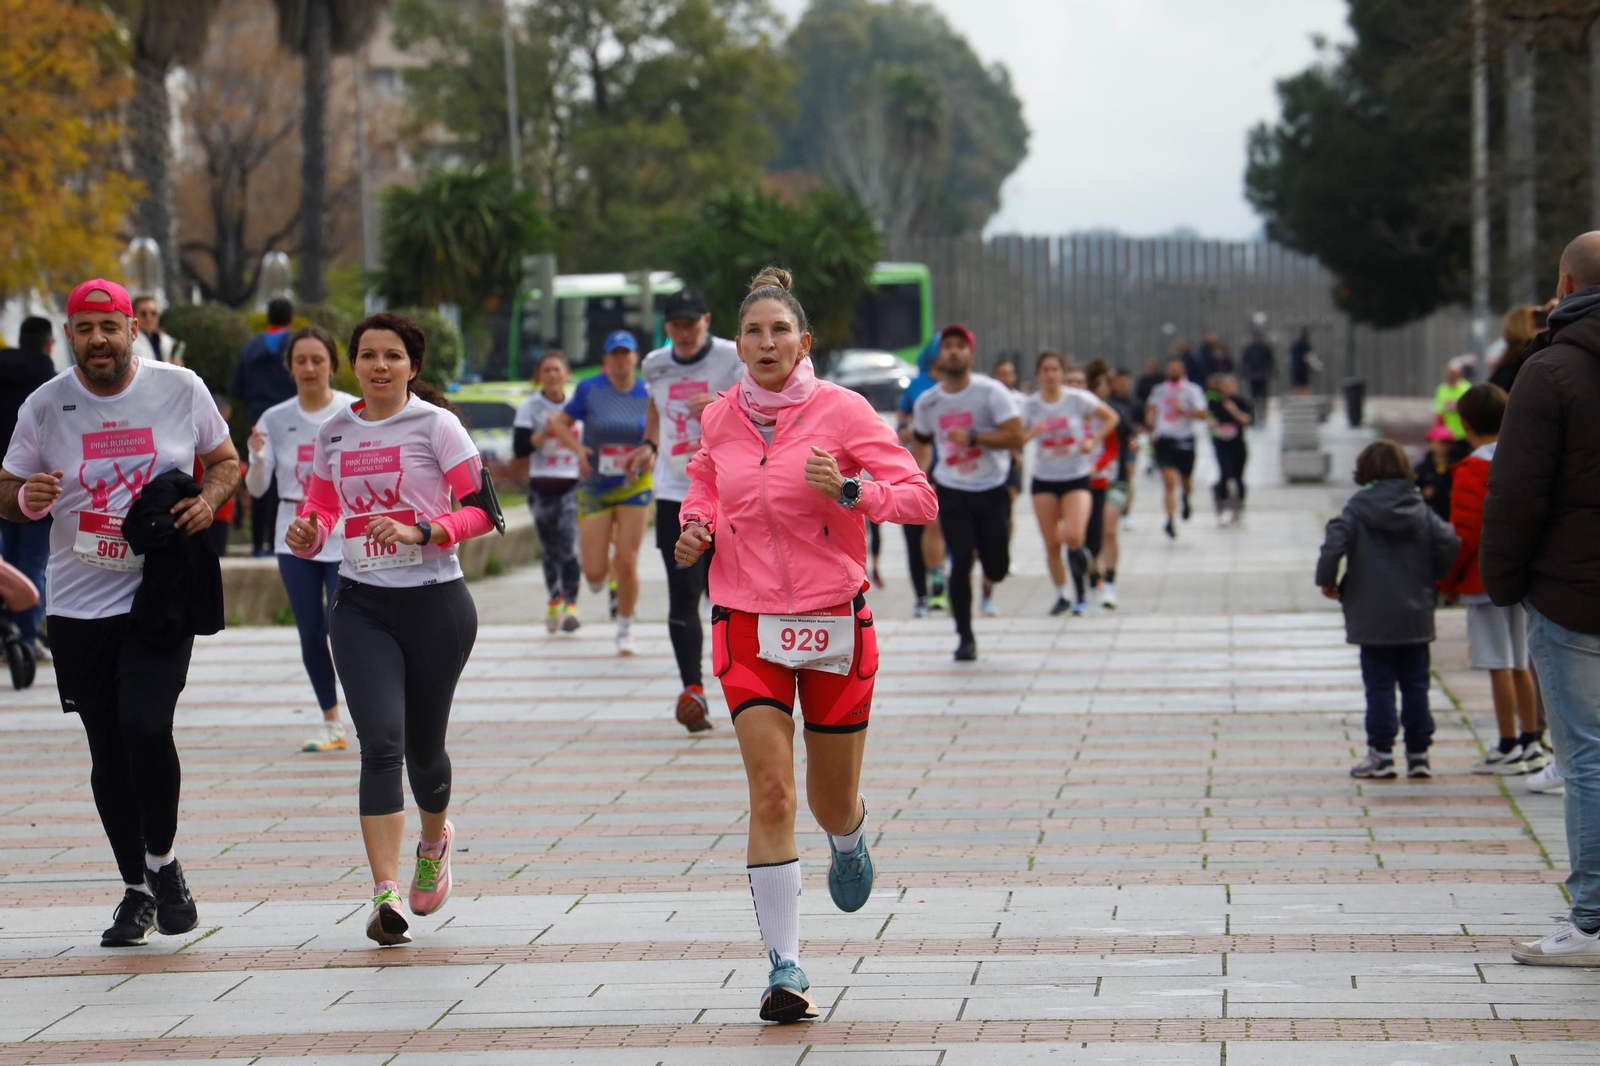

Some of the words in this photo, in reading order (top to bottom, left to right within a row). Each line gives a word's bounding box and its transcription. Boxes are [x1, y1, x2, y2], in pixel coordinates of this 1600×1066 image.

[90, 440, 109, 449] PINK
[110, 438, 146, 448] RUNNING
[101, 447, 125, 455] CADENA
[345, 459, 361, 467] PINK
[362, 456, 393, 465] RUNNING
[97, 540, 128, 559] 967
[780, 627, 829, 652] 929
